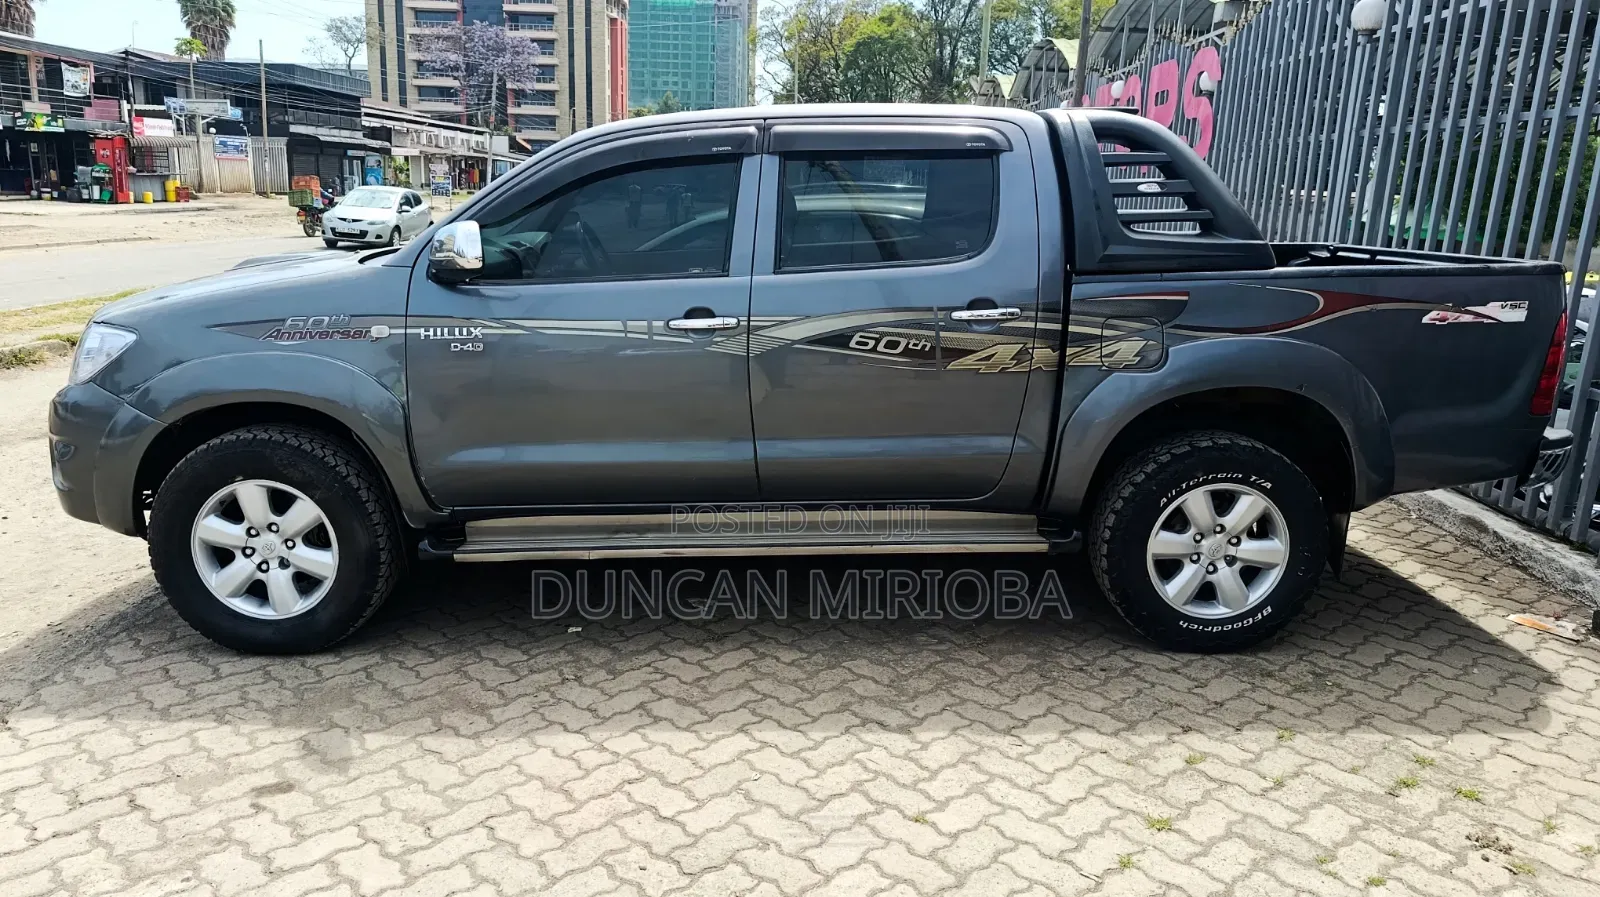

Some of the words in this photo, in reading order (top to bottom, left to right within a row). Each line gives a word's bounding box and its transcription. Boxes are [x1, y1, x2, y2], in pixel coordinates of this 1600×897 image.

[1500, 301, 1527, 310] VSC
[284, 313, 350, 329] 60th
[420, 326, 483, 340] HILUX
[450, 342, 484, 352] D-4D
[848, 331, 932, 355] 60th
[1159, 471, 1243, 507] All-Terrain
[1249, 475, 1273, 490] T/A
[1178, 605, 1273, 633] BFGoodrich
